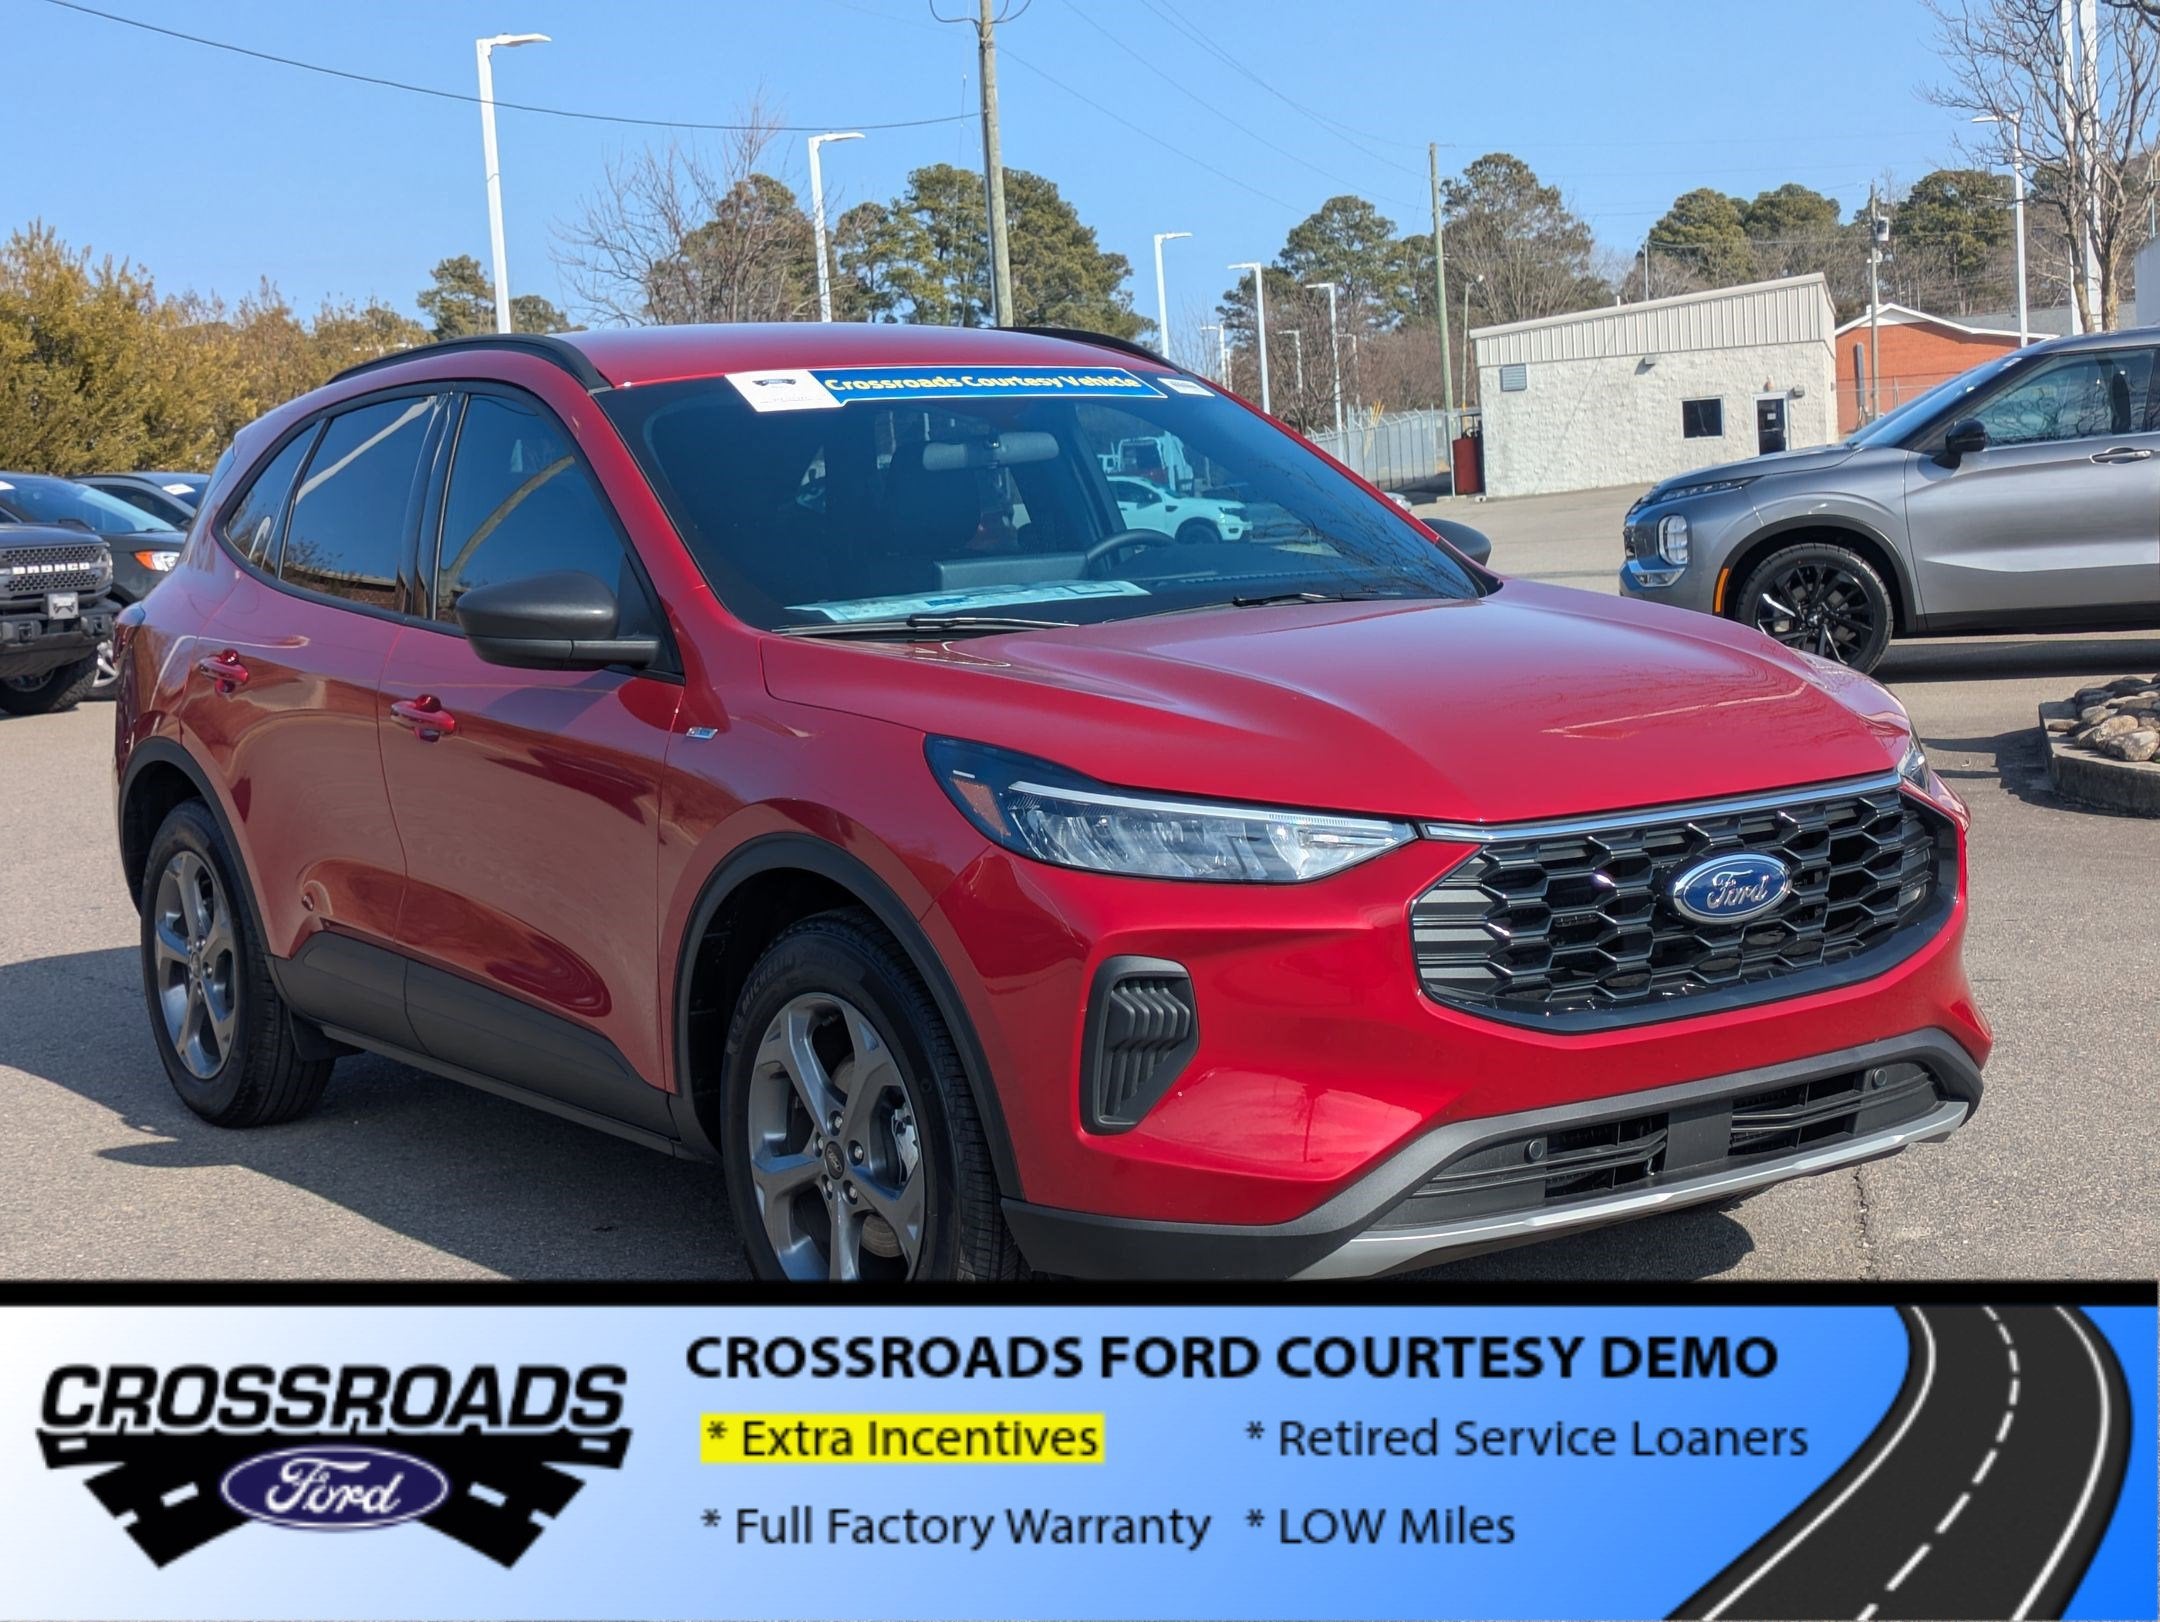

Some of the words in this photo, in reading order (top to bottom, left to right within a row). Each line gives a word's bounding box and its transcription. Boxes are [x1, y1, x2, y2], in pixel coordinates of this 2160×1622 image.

[823, 376, 963, 391] Crossroads
[961, 376, 1064, 389] Courtesy
[1059, 375, 1142, 388] Vehicle
[1706, 869, 1769, 910] Ford
